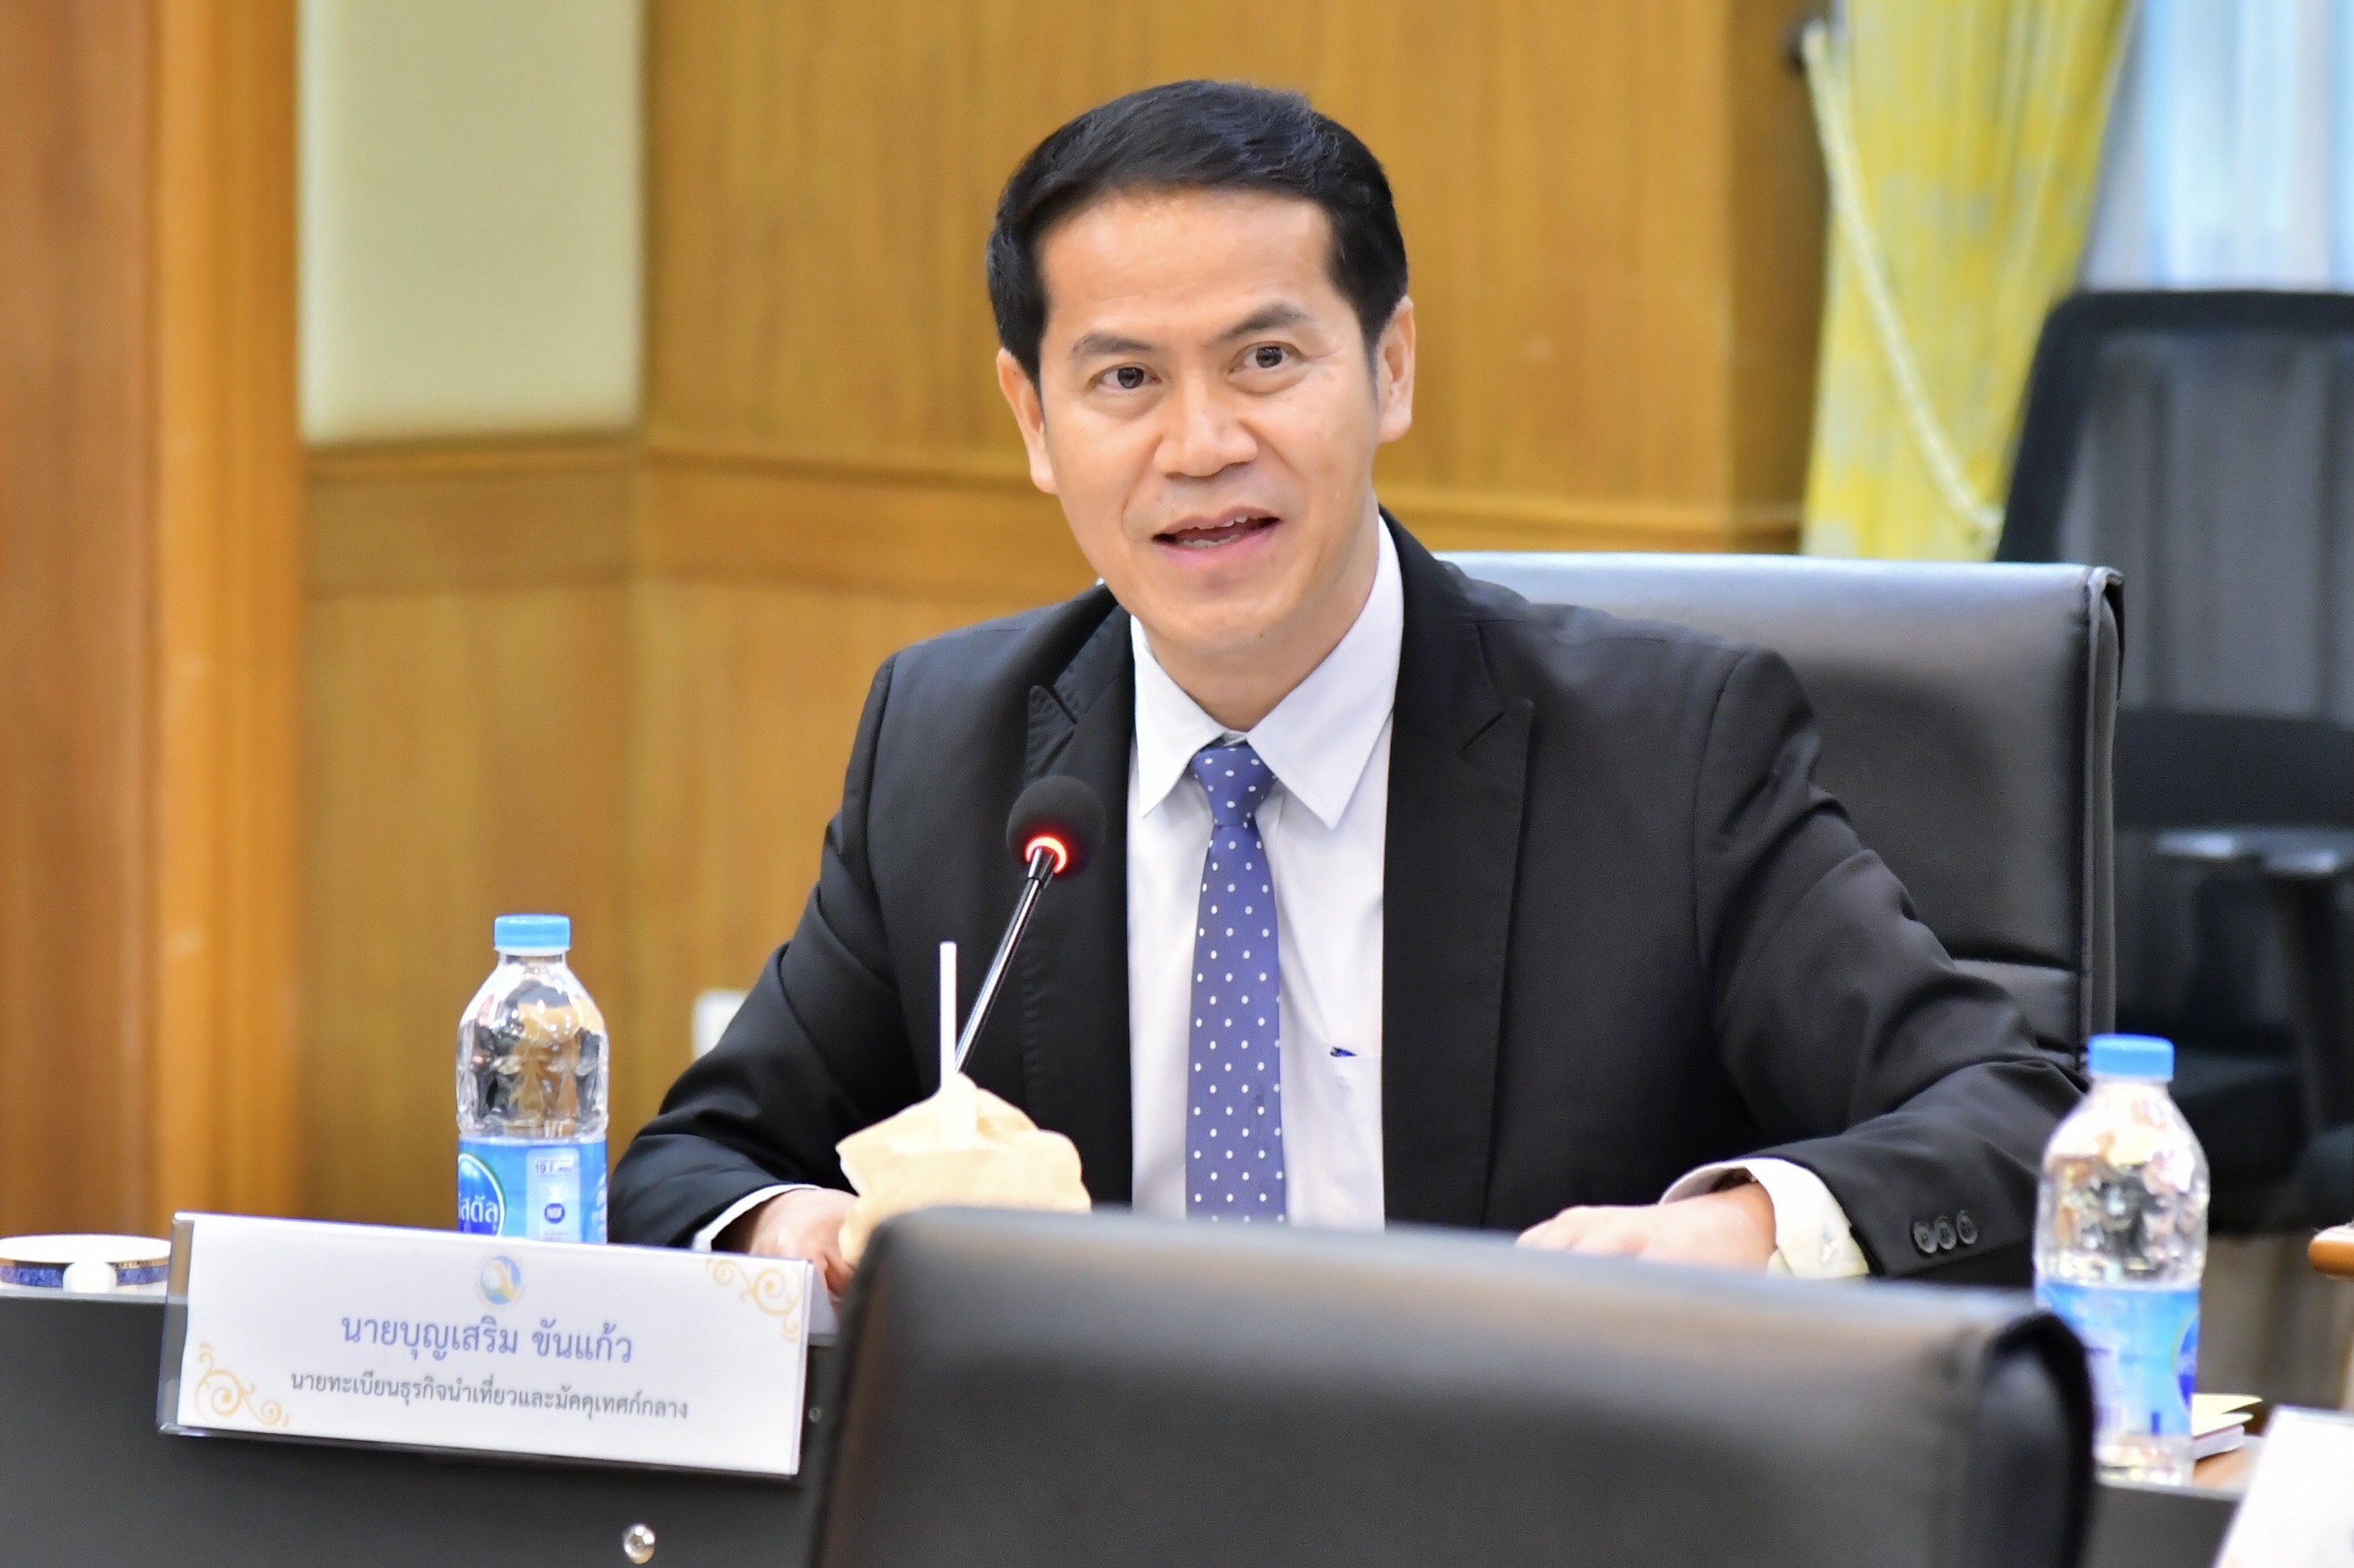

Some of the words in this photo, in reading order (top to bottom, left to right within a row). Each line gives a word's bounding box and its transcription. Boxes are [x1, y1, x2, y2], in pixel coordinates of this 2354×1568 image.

[459, 1194, 498, 1223] สตัล
[341, 1315, 518, 1361] นายบุญเสริม
[531, 1318, 633, 1363] ขันแก้ว
[290, 1370, 689, 1420] นายทะเบียนธุรกิจนำเที่ยวและมัคคุเทศก์กลาง
